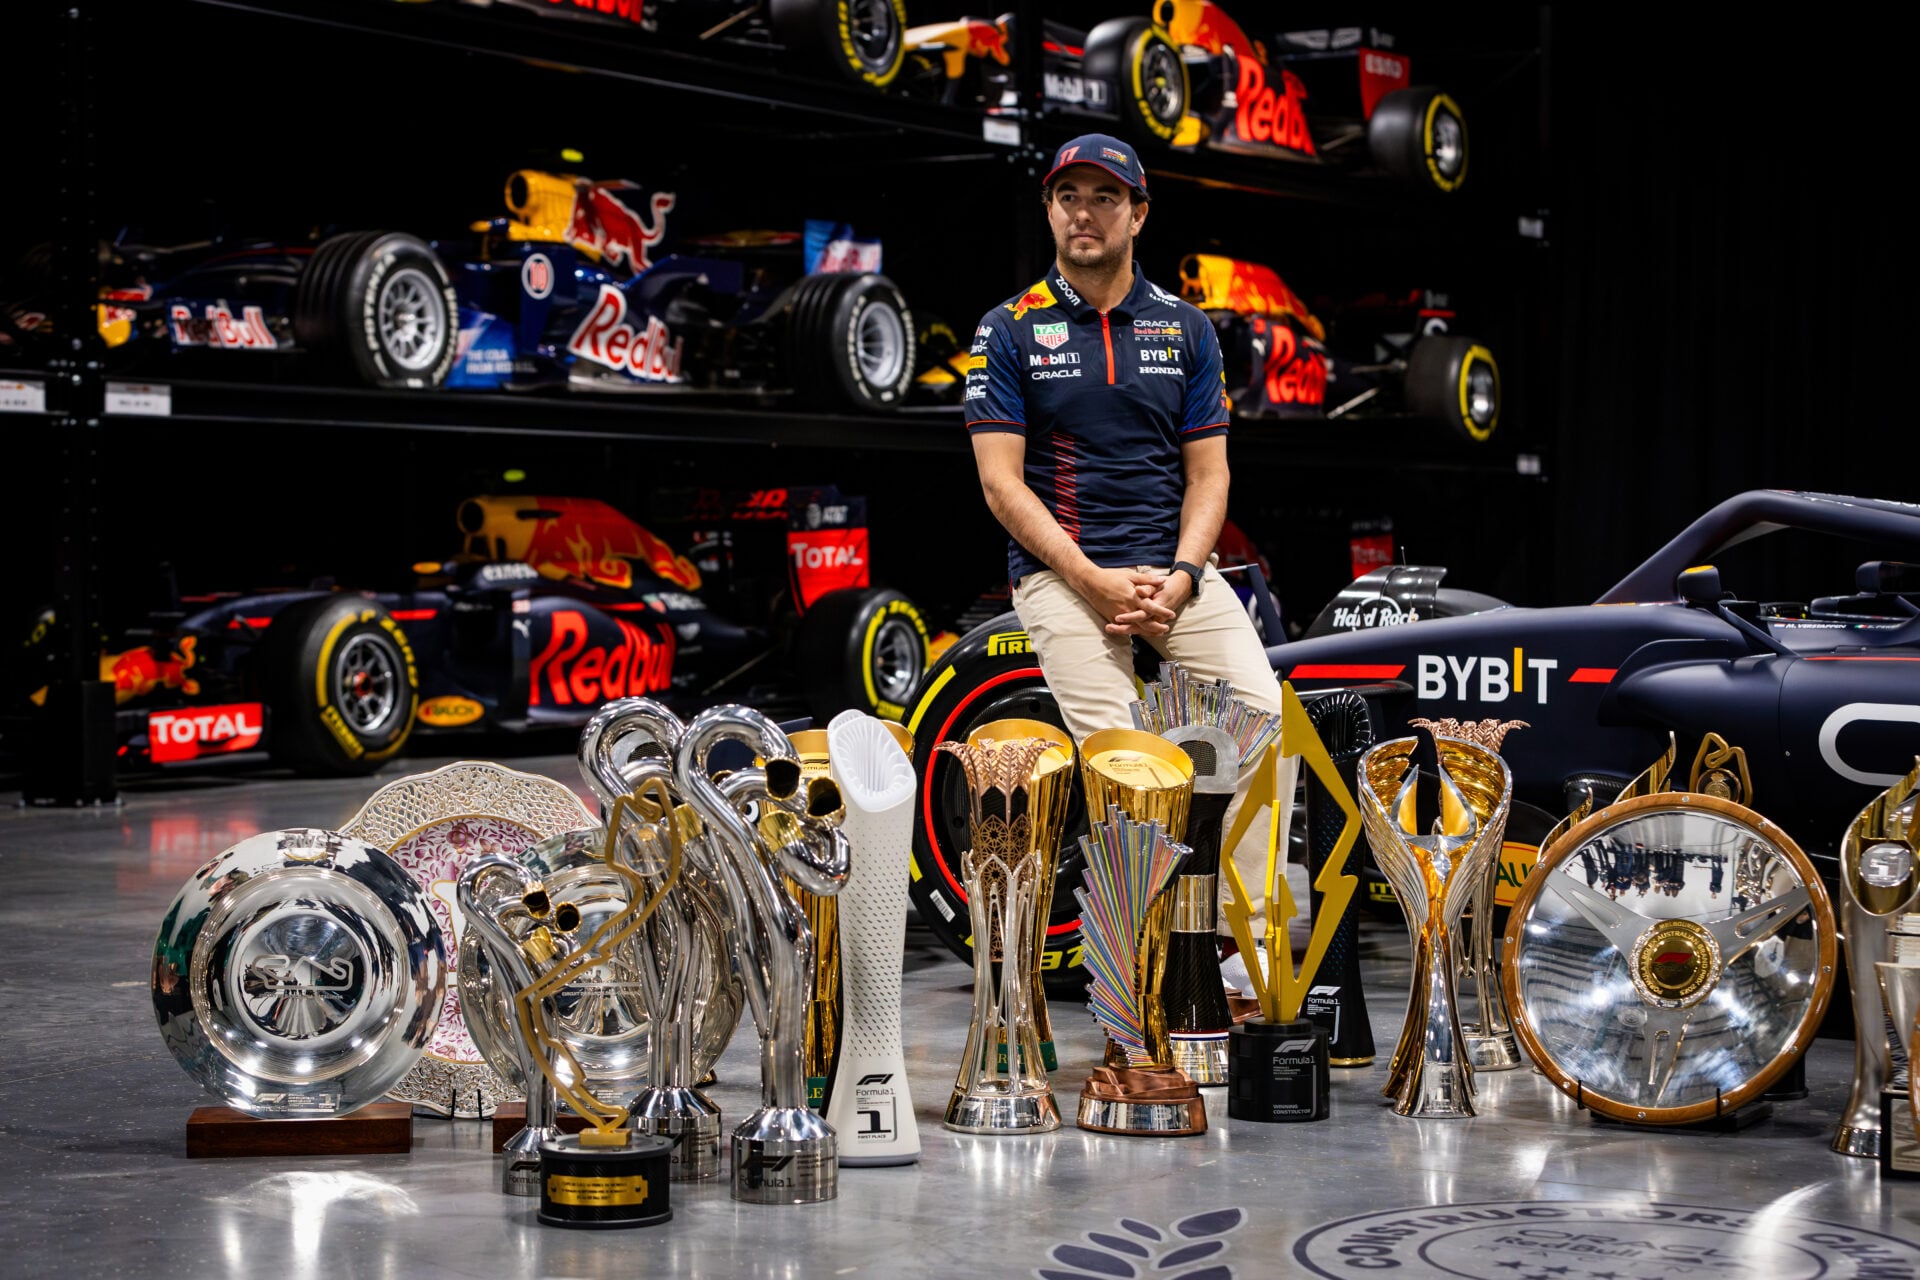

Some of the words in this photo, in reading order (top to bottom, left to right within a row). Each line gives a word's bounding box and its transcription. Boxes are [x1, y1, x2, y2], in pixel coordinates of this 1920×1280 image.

[1055, 275, 1081, 306] zoom
[1035, 324, 1066, 335] TAG
[1133, 319, 1181, 329] ORACLE
[1035, 334, 1067, 347] HEUER
[1029, 353, 1067, 366] Mobil
[1140, 346, 1181, 362] BYBIT
[1031, 369, 1082, 380] ORACLE
[1138, 366, 1184, 376] HONDA
[790, 542, 863, 570] TOTAL
[1378, 606, 1419, 627] Rock
[1418, 647, 1558, 705] BYBIT
[1272, 1056, 1309, 1065] Formula
[856, 1089, 890, 1097] Formula
[857, 1110, 892, 1134] 1
